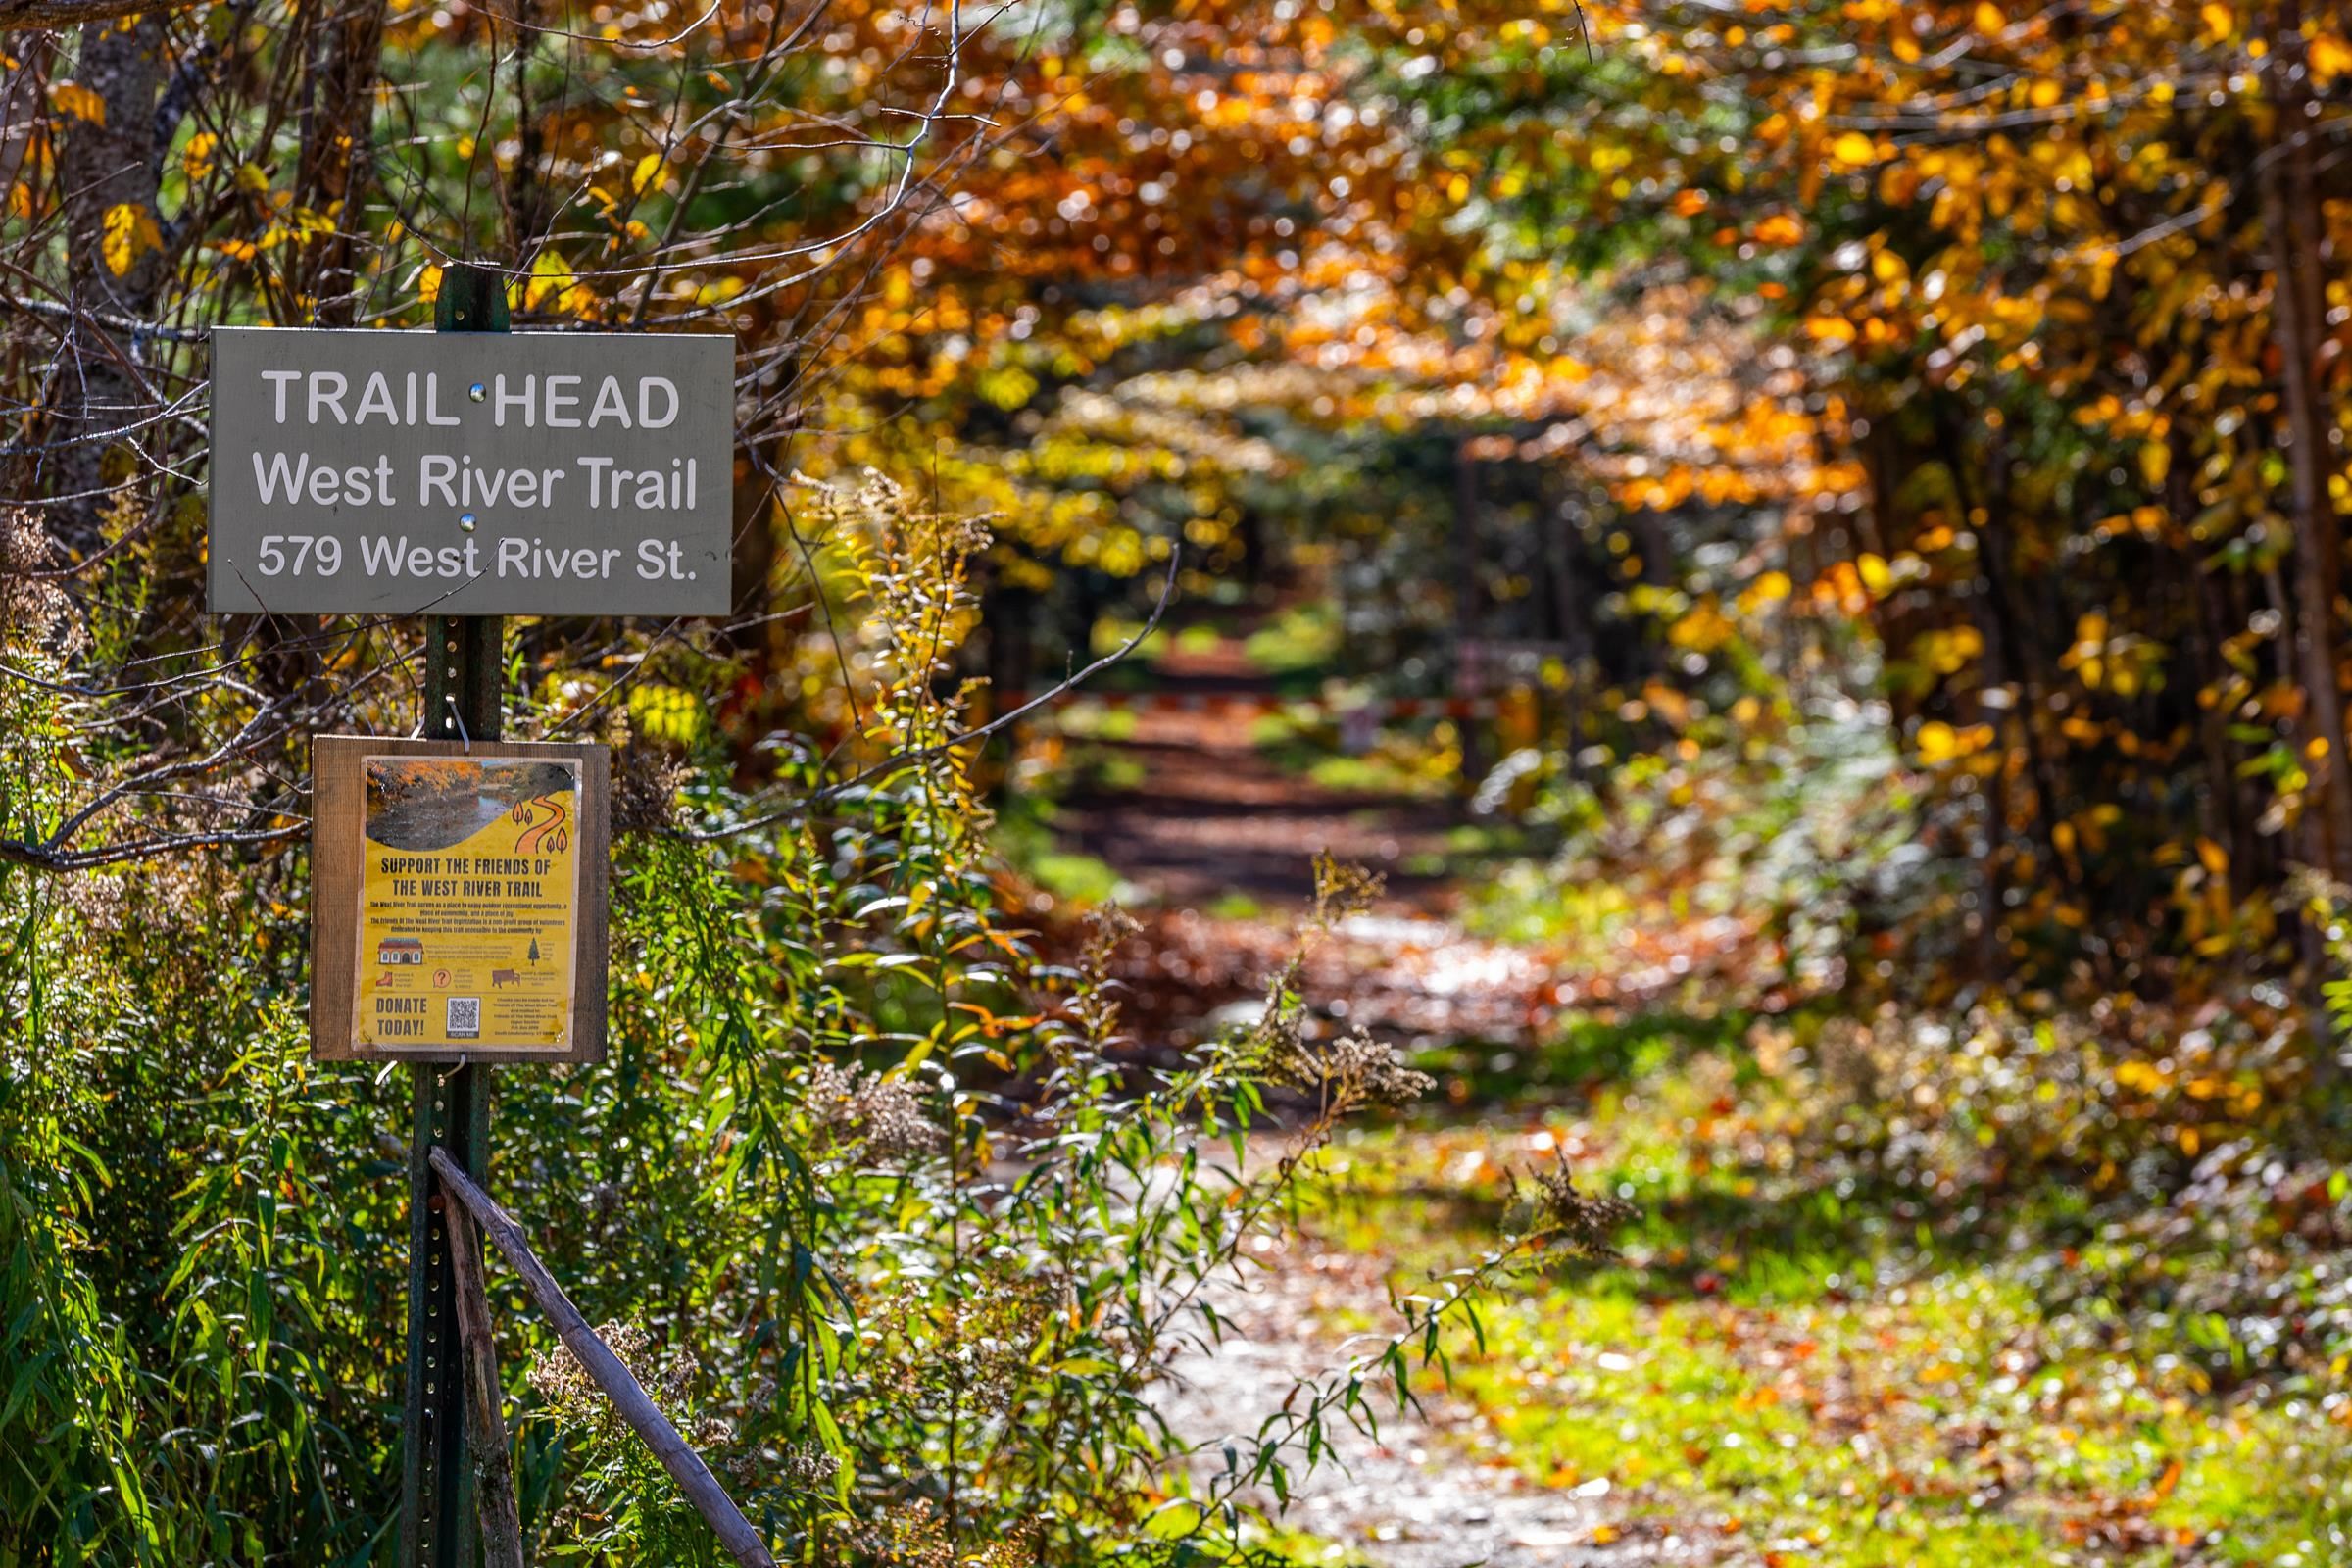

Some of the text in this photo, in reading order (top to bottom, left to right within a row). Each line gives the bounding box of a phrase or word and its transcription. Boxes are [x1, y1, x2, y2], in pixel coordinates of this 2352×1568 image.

[260, 370, 680, 430] TRAIL HEAD
[252, 452, 697, 510] West River Trail
[258, 535, 697, 581] 579 West River St.
[381, 858, 551, 875] SUPPORT THE FRIENDS OF
[393, 879, 542, 897] THE WEST RIVER TRAIL
[376, 998, 427, 1013] DONATE
[377, 1019, 423, 1035] TODAY!
